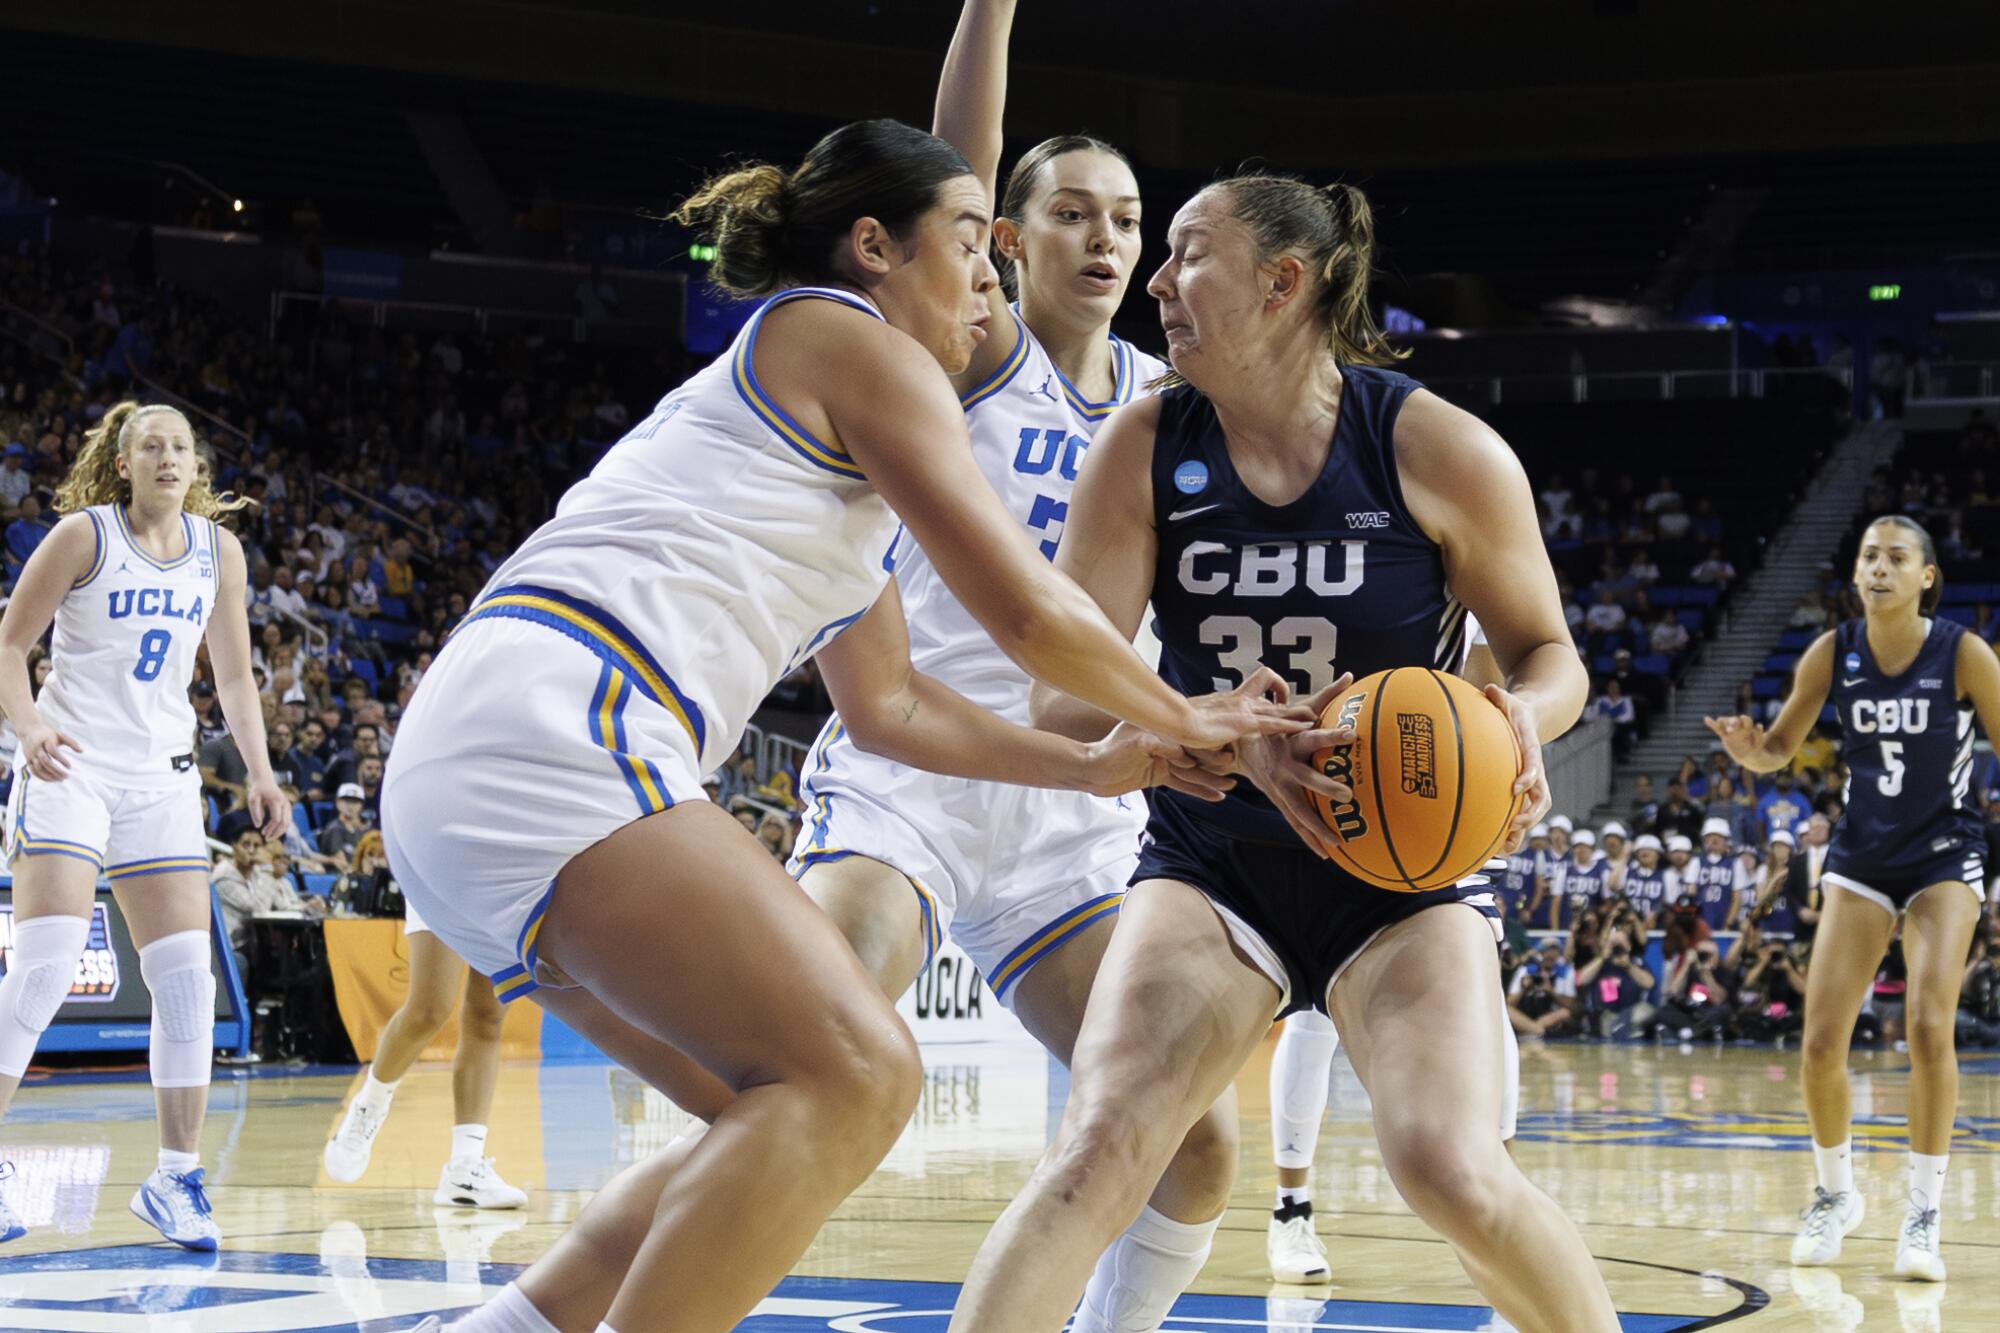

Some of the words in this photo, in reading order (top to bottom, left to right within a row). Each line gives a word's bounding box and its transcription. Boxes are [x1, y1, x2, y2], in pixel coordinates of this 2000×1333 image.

[1013, 427, 1089, 482] UC
[1345, 512, 1390, 528] WAC
[1177, 540, 1368, 596] CBU
[108, 588, 203, 627] UCLA
[133, 628, 172, 682] 8
[1199, 615, 1338, 707] 33
[1852, 698, 1930, 734] CBU
[1323, 691, 1369, 843] Wlon
[1402, 735, 1417, 781] MARCH
[1415, 714, 1432, 775] MADNESS
[1878, 740, 1906, 797] 5
[916, 957, 982, 1019] UCLA
